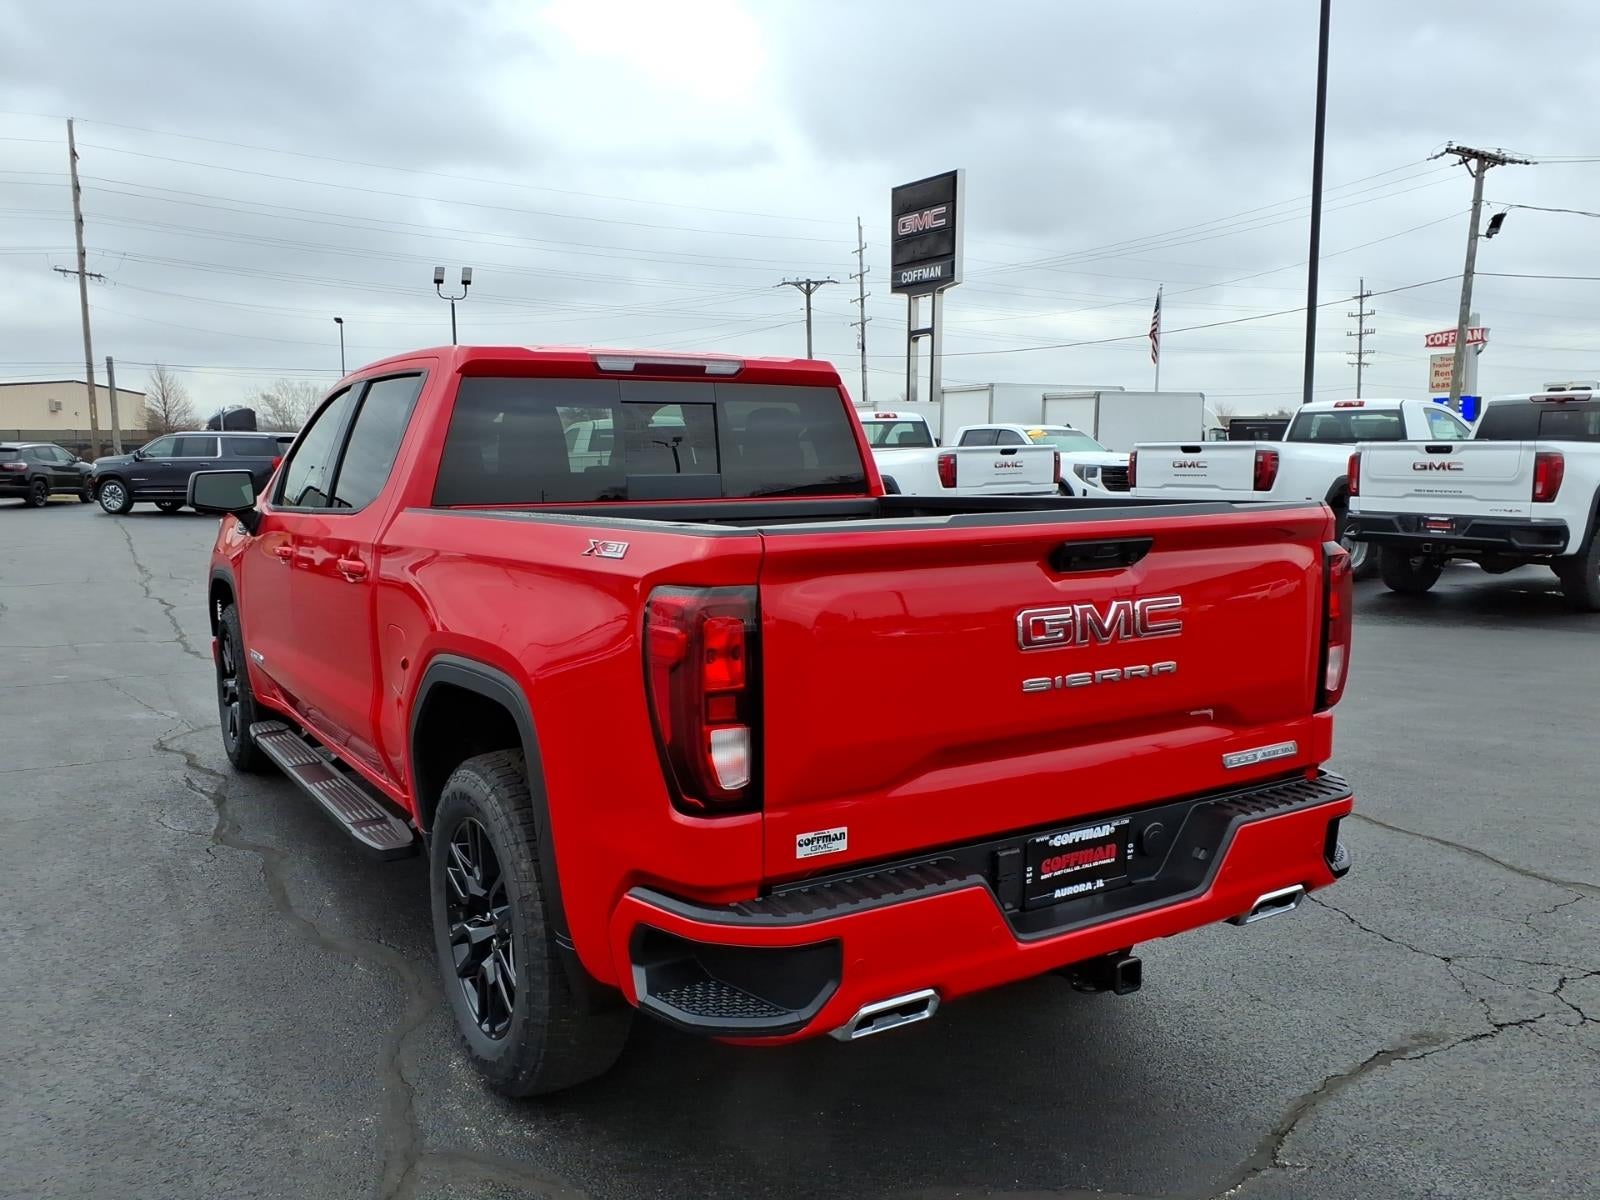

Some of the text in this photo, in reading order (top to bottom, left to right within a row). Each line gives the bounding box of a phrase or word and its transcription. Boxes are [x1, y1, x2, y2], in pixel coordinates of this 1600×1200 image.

[898, 206, 946, 236] GMC
[901, 265, 941, 283] COFFMAN
[1427, 329, 1482, 345] COFFAN
[1172, 460, 1208, 468] GMC
[1412, 461, 1464, 471] GMC
[581, 539, 629, 559] X31
[1016, 595, 1183, 650] GMC
[1022, 661, 1177, 692] SIERRA
[798, 832, 845, 848] COFFMAN
[1054, 825, 1110, 846] COFFMAN
[811, 843, 833, 852] GMC
[1041, 843, 1117, 874] COFFMAN
